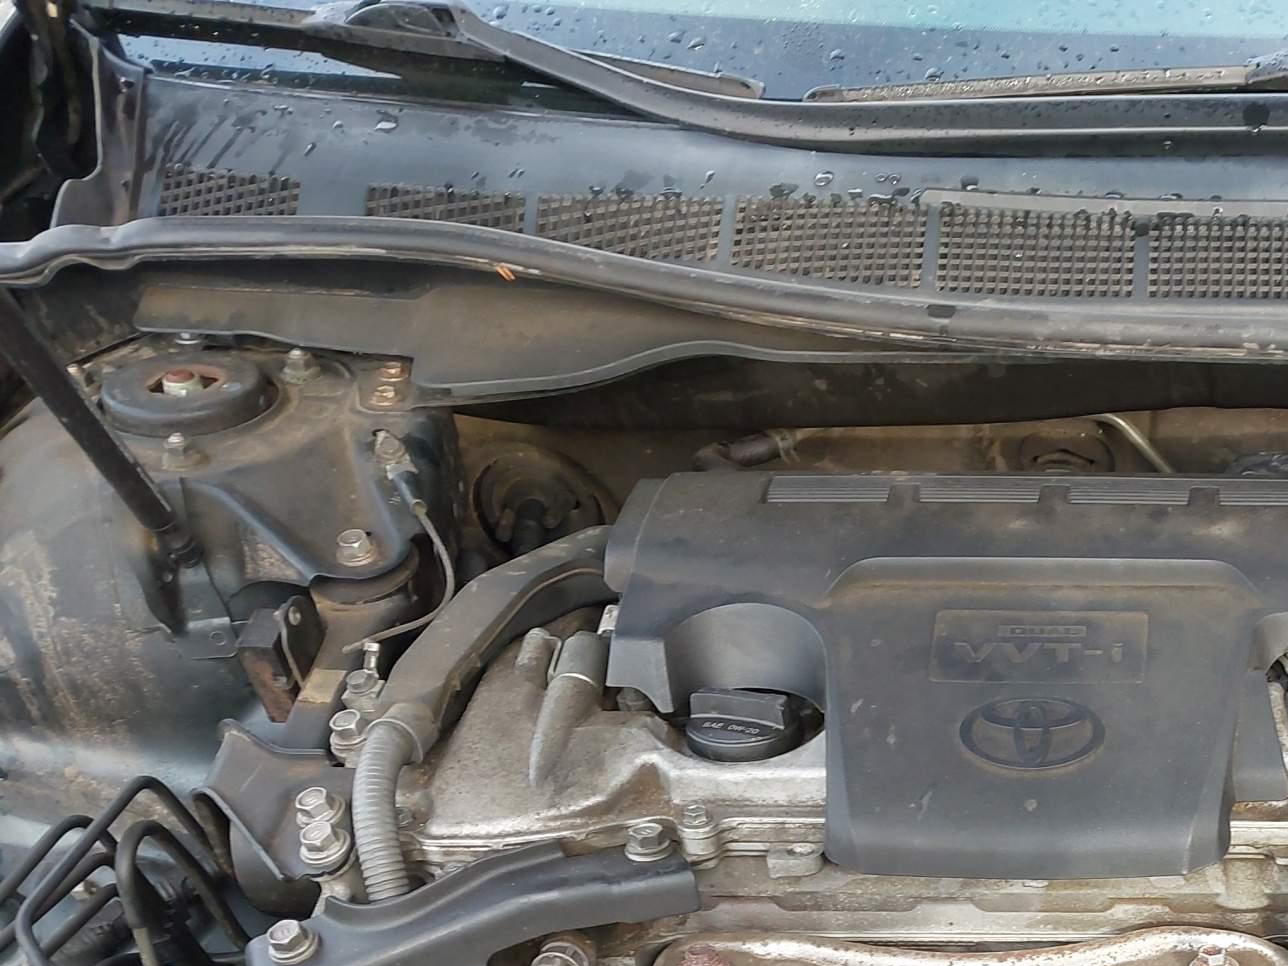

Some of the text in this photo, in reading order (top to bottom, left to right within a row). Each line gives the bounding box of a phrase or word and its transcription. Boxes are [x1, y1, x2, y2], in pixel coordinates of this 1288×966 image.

[953, 641, 1124, 663] VVT-i
[702, 720, 760, 735] SAE 0W-20
